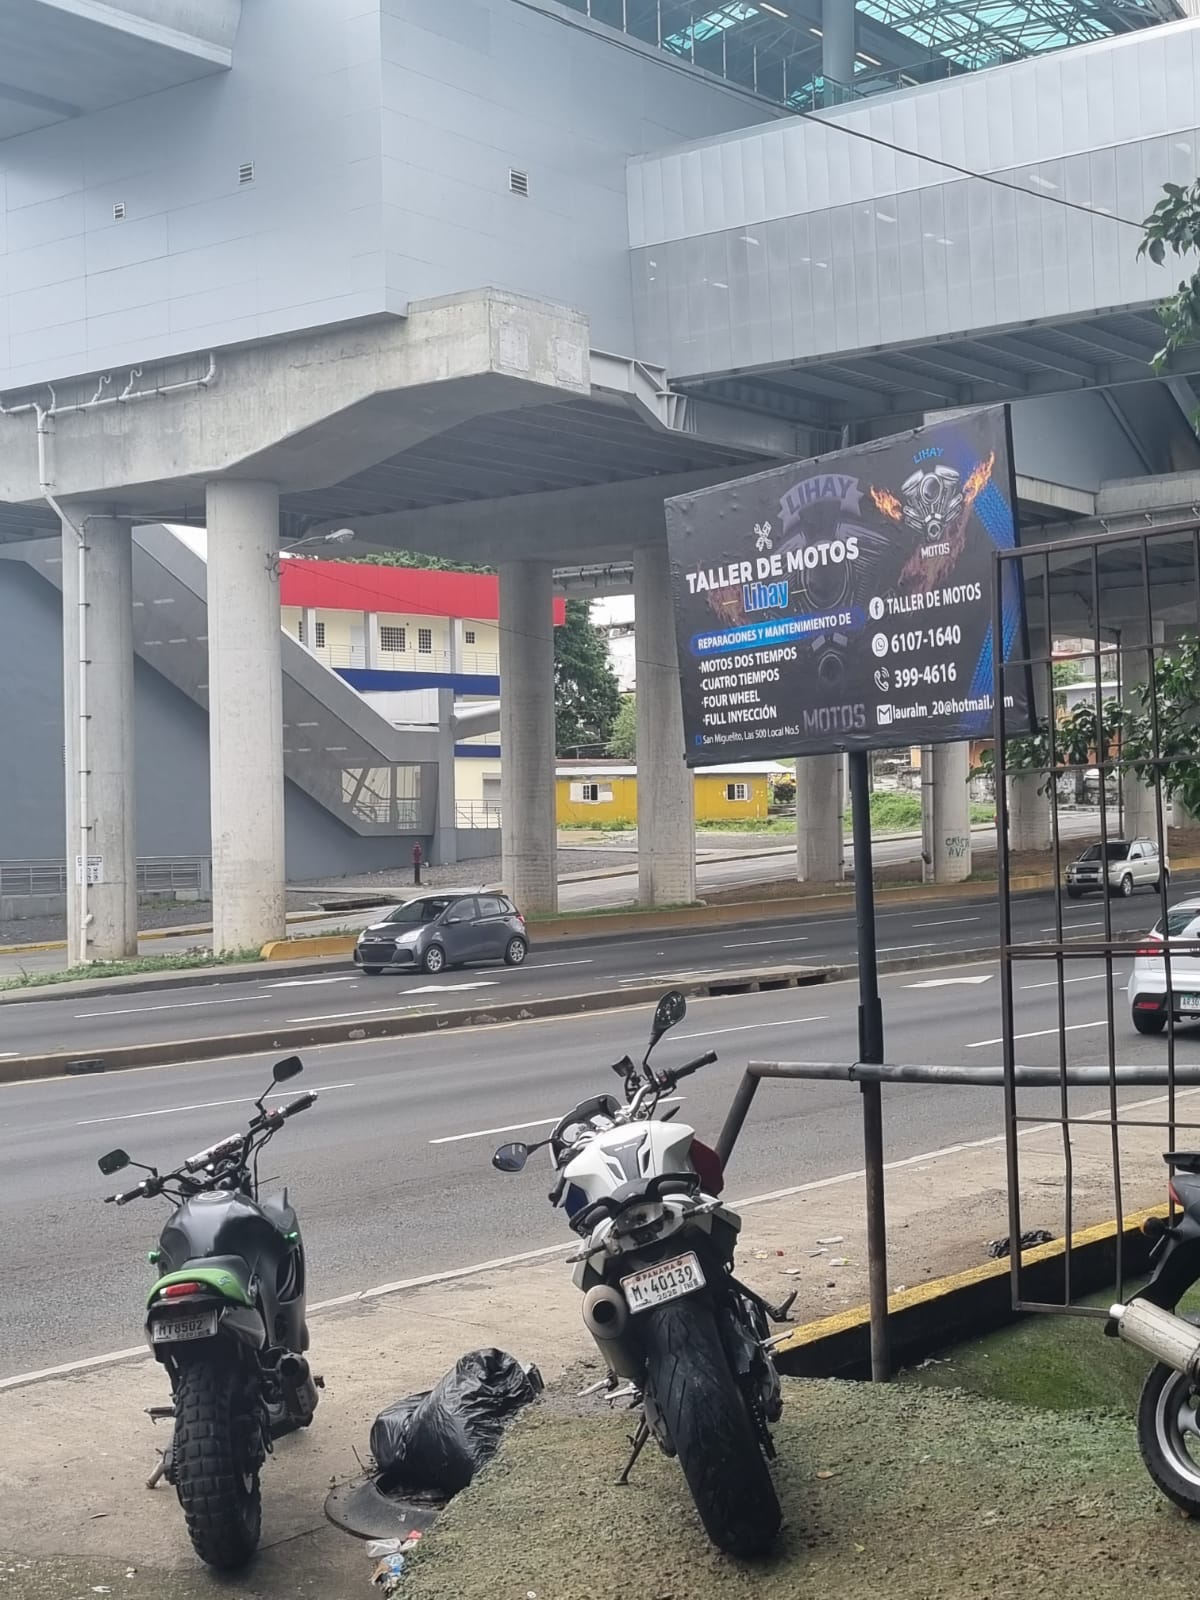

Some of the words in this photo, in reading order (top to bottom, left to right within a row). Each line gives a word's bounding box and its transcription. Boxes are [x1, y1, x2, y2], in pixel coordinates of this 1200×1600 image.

[913, 447, 944, 465] LIHAY
[785, 476, 855, 515] LIHAY
[921, 543, 950, 559] MOTOS
[686, 561, 753, 594] TALLER
[756, 554, 783, 579] DE
[786, 537, 859, 573] MOTOS
[742, 580, 789, 613] Lihay
[887, 593, 924, 615] TALLER
[926, 590, 941, 608] DE
[942, 582, 982, 605] MOTOS
[698, 630, 757, 650] REPARACIONES
[758, 629, 764, 639] Y
[765, 616, 838, 639] MANTENIMIENTO
[838, 612, 852, 626] DE
[891, 624, 961, 653] 6107-1640
[701, 657, 733, 674] MOTOS
[734, 654, 754, 669] DOS
[756, 647, 797, 666] TIEMPOS
[702, 674, 738, 690] CUATRO
[738, 668, 780, 685] TIEMPOS
[894, 662, 957, 689] 399-4616
[703, 694, 728, 708] FOUR
[728, 690, 760, 706] WHEEL
[892, 694, 1014, 720] lauralm_20@hotmail.m
[705, 711, 726, 726] FULL
[727, 704, 777, 723] INYECCIÓN
[803, 703, 866, 735] MOTOS
[703, 734, 714, 744] San
[714, 731, 743, 745] Miguelito,
[744, 731, 755, 740] Las
[755, 728, 767, 739] 500
[767, 727, 784, 738] Local
[784, 724, 800, 735] No.5
[643, 1264, 676, 1279] PANAMA
[159, 1320, 203, 1336] MT8502
